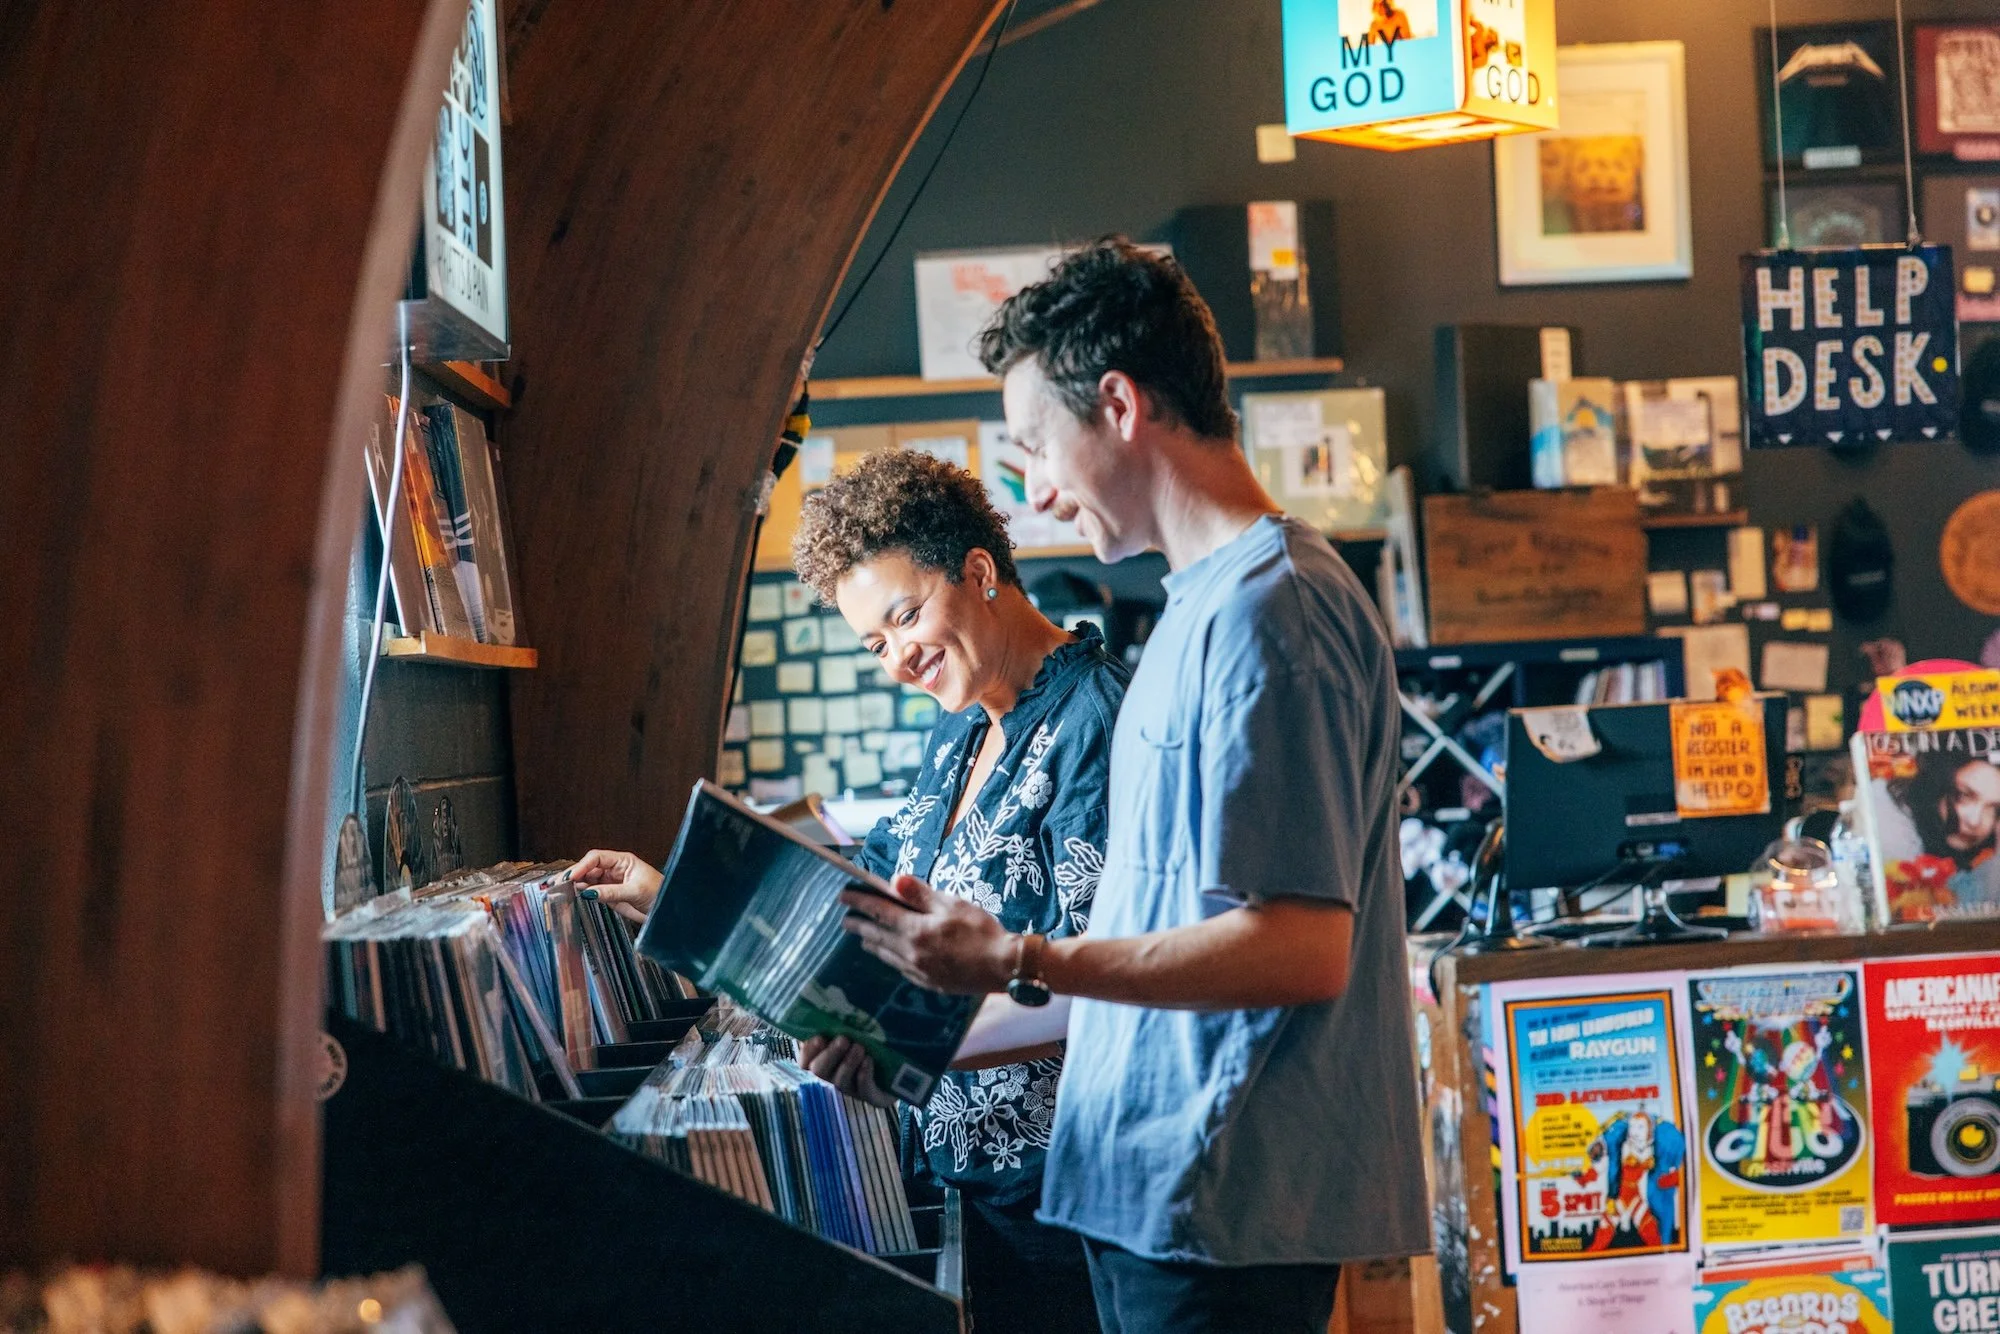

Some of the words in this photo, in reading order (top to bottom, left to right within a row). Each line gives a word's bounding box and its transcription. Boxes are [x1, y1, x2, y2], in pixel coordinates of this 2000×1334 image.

[1340, 27, 1401, 70] MY
[1310, 68, 1404, 112] GOD
[1487, 65, 1540, 105] GOD
[1756, 256, 1929, 332] HELP
[1762, 332, 1938, 416] DESK
[1731, 720, 1742, 736] A
[1691, 780, 1733, 800] HELP
[1569, 1036, 1657, 1060] RAYGUN
[1570, 1086, 1659, 1104] SATURDAYS
[1540, 1188, 1560, 1218] 5
[1564, 1192, 1602, 1212] SPOT
